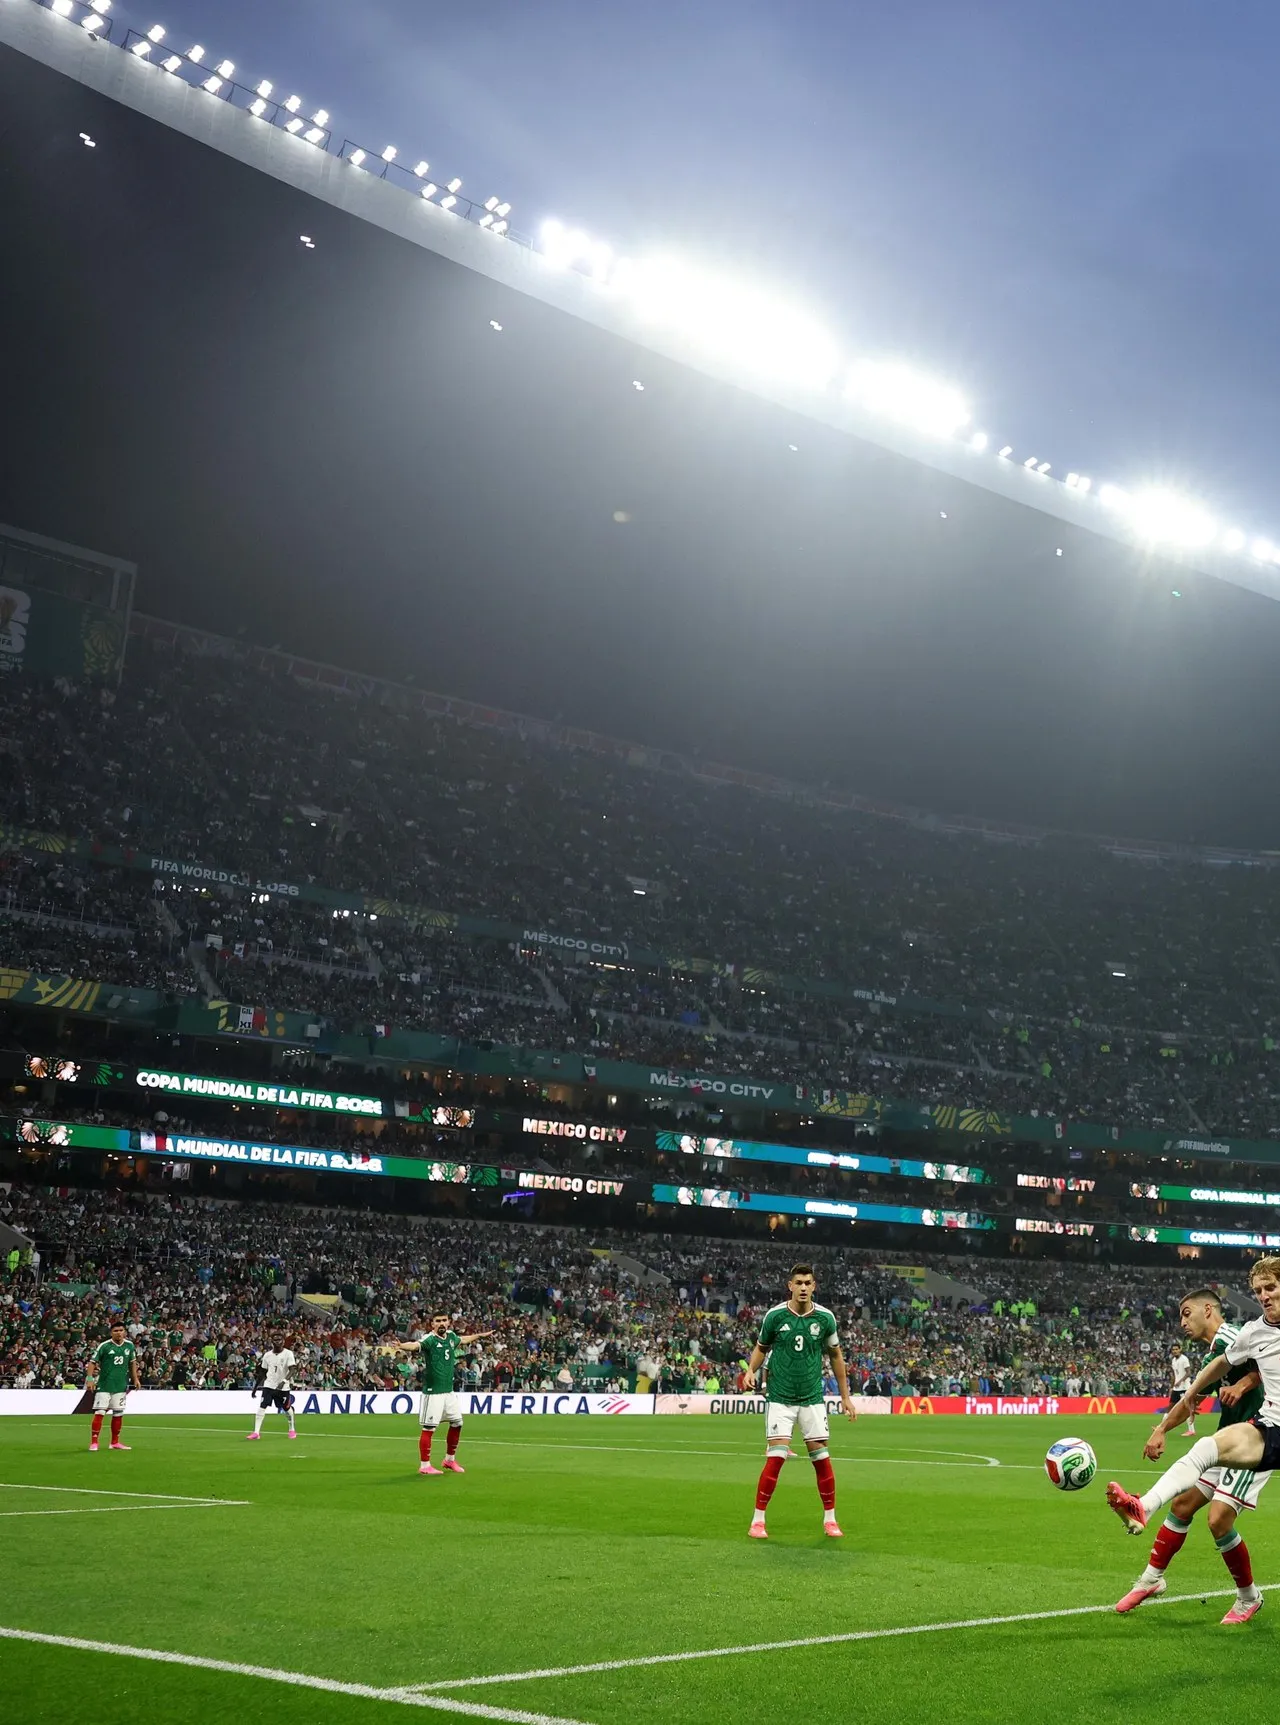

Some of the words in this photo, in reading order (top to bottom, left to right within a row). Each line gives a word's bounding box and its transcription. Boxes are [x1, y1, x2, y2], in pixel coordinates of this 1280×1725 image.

[151, 859, 178, 873] FIFA
[182, 864, 228, 882] WORLD
[524, 930, 587, 950] MEXICO
[136, 1072, 181, 1090] COPA
[184, 1078, 254, 1099] MUNDIAL
[257, 1087, 277, 1101] DE
[279, 1090, 299, 1104] LA
[301, 1093, 333, 1108] FIFA
[650, 1073, 726, 1092] MEXCO
[730, 1084, 773, 1099] CITY
[523, 1118, 586, 1138] MEXICO
[590, 1126, 626, 1142] CITY
[176, 1138, 248, 1159] MUNDIAL
[251, 1147, 271, 1161] DE
[273, 1150, 294, 1164] LA
[296, 1152, 327, 1166] FIFA
[519, 1173, 583, 1192] MEXICO
[586, 1180, 623, 1195] CITY
[1190, 1189, 1218, 1201] COPA
[1219, 1191, 1265, 1204] MUNDIAL
[1267, 1194, 1280, 1204] DE
[1190, 1232, 1218, 1244] COPA
[1219, 1233, 1265, 1246] MUNDIAL
[1266, 1236, 1280, 1246] DE
[795, 1335, 803, 1351] 3
[114, 1356, 124, 1365] 23
[445, 1349, 450, 1360] 5
[470, 1395, 590, 1414] MERICA
[710, 1400, 765, 1414] CIUDAD
[966, 1397, 993, 1414] i'm
[997, 1397, 1043, 1414] lovin'
[1046, 1397, 1059, 1414] it
